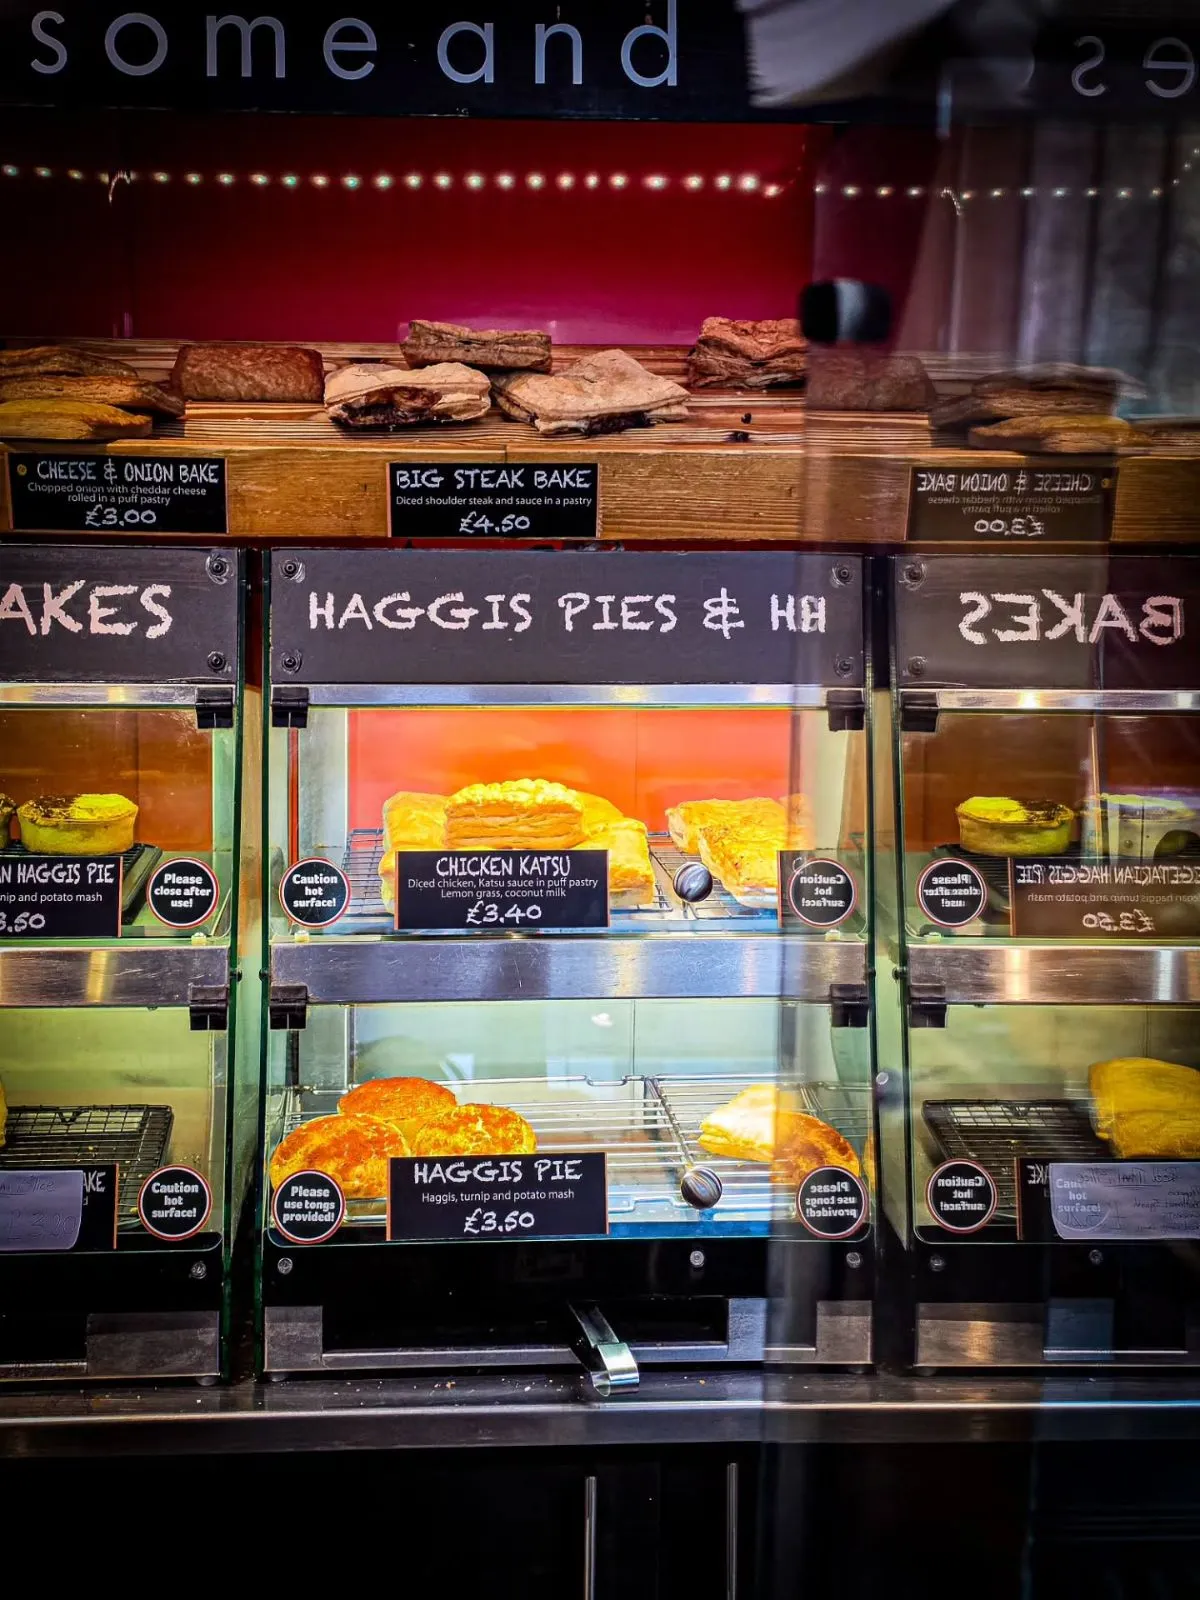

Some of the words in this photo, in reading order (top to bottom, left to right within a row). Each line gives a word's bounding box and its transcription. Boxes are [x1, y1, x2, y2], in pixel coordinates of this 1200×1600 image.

[31, 11, 378, 80] some
[437, 0, 678, 87] and
[37, 460, 96, 480] CHEESE
[104, 458, 117, 485] &
[124, 463, 173, 482] ONION
[179, 463, 219, 484] BAKE
[396, 469, 444, 488] BIG
[453, 468, 525, 489] STEAK
[534, 468, 592, 489] BAKE
[27, 482, 73, 493] Chopped
[76, 484, 104, 493] onion
[106, 485, 128, 494] with
[130, 485, 171, 495] cheddar
[173, 486, 207, 496] cheese
[68, 493, 96, 503] rolled
[98, 493, 108, 503] in
[118, 493, 138, 505] puff
[140, 496, 171, 506] pastry
[396, 496, 423, 505] Diced
[425, 496, 467, 506] shoulder
[468, 496, 493, 506] steak
[495, 496, 514, 506] and
[515, 498, 542, 506] sauce
[544, 496, 553, 505] in
[555, 498, 561, 506] a
[563, 498, 592, 507] pastry
[85, 504, 157, 527] £3.00
[459, 511, 530, 533] £4.50
[0, 580, 174, 639] AKES
[309, 591, 532, 634] HAGGIS
[558, 592, 678, 634] PIES
[703, 588, 744, 640] &
[436, 856, 513, 877] CHICKEN
[519, 855, 571, 876] KATSU
[17, 863, 81, 884] HAGGIS
[87, 863, 115, 884] PIE
[164, 873, 203, 885] Please
[292, 873, 338, 885] Caution
[408, 879, 436, 890] Diced
[438, 878, 476, 889] chicken,
[478, 878, 505, 888] Katsu
[507, 880, 535, 888] sauce
[536, 878, 545, 888] in
[547, 878, 567, 890] puff
[569, 879, 598, 890] pastry
[154, 887, 181, 896] close
[183, 886, 211, 897] after
[305, 886, 323, 896] hot
[441, 889, 474, 899] Lemon
[477, 890, 503, 900] grass,
[505, 890, 544, 898] coconut
[546, 888, 567, 898] milk
[18, 893, 37, 902] and
[40, 893, 73, 903] potato
[75, 893, 102, 902] mash
[171, 899, 193, 908] use!
[293, 898, 336, 908] surface!
[466, 900, 542, 924] £3.40
[414, 1161, 522, 1183] HAGGIS
[534, 1159, 583, 1181] PIE
[152, 1182, 199, 1193] Caution
[291, 1186, 330, 1197] Please
[164, 1195, 183, 1205] hot
[422, 1193, 458, 1203] Haggis,
[460, 1193, 489, 1202] turnip
[491, 1191, 511, 1201] and
[513, 1192, 546, 1202] potato
[548, 1189, 575, 1199] mash
[284, 1200, 305, 1209] use
[307, 1199, 335, 1212] tongs
[152, 1208, 197, 1217] surface!
[283, 1211, 335, 1224] provided!
[464, 1208, 535, 1233] £3.50
